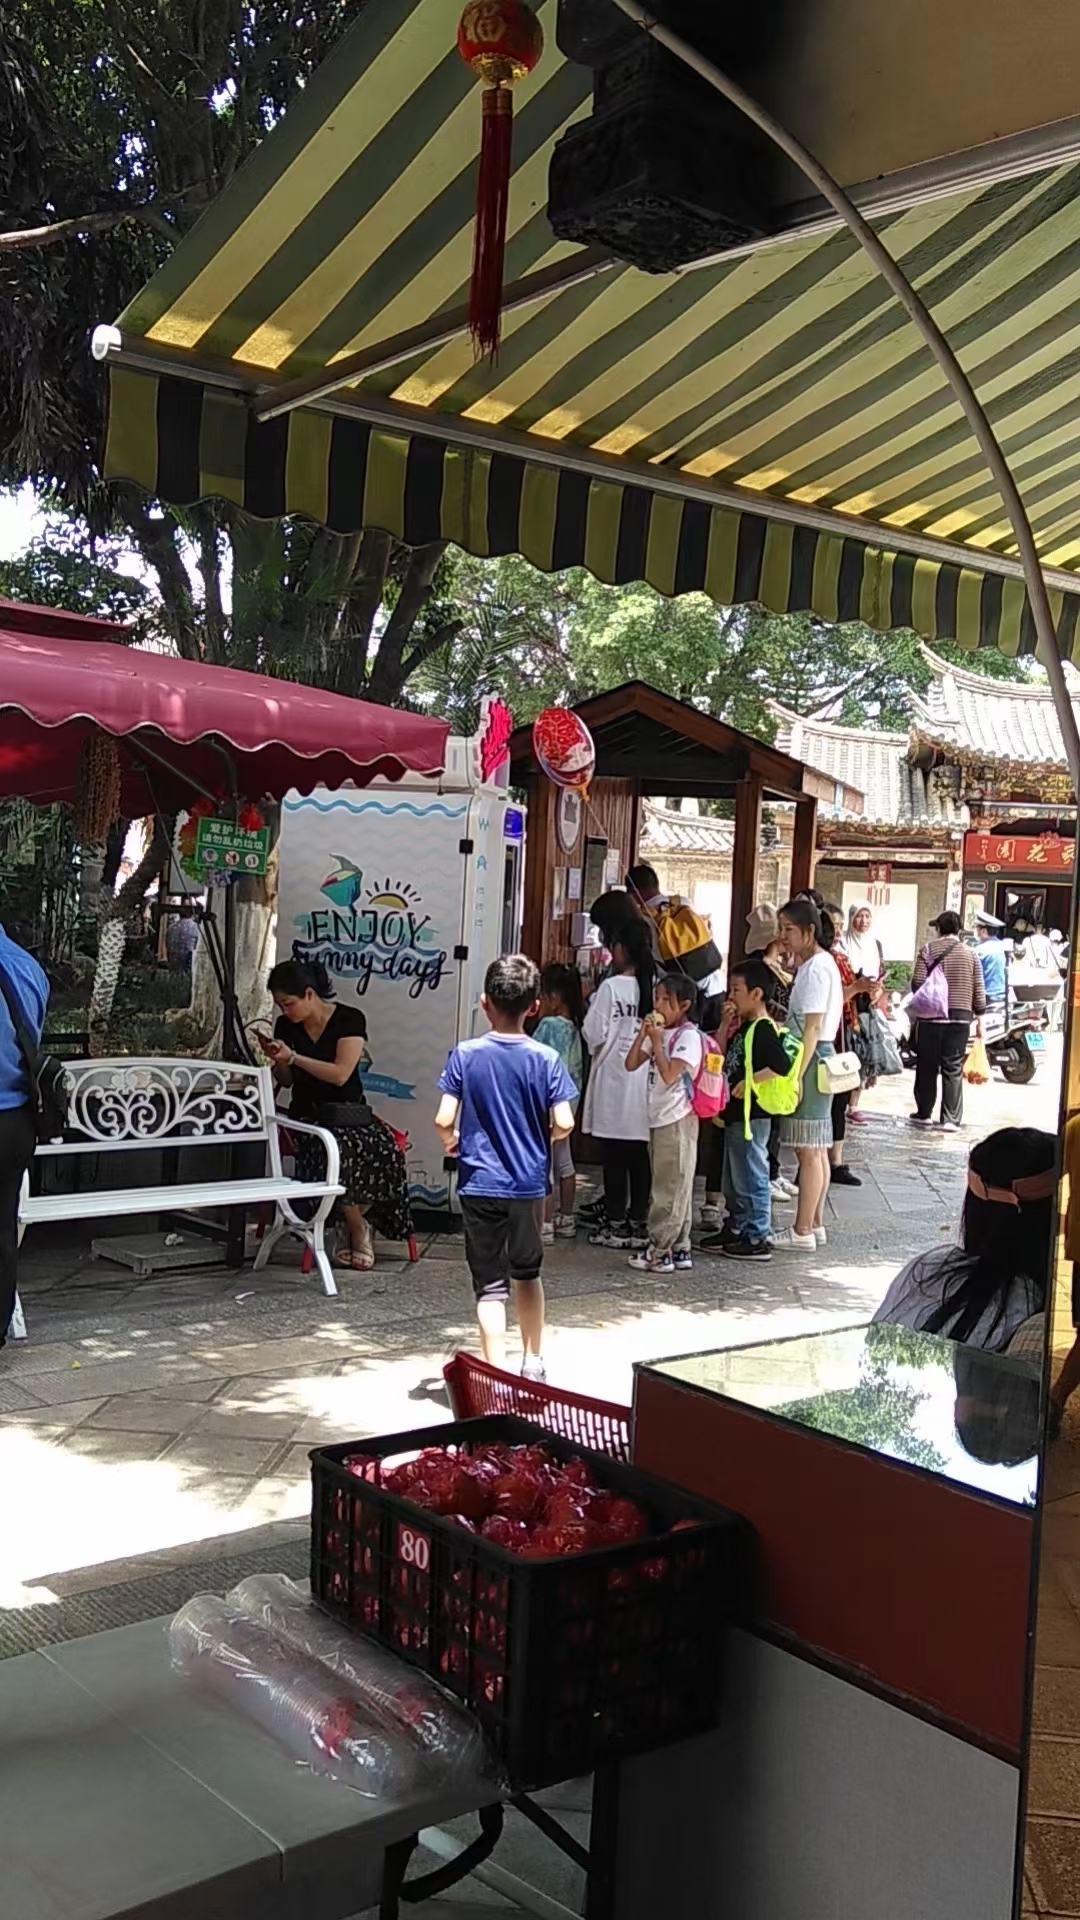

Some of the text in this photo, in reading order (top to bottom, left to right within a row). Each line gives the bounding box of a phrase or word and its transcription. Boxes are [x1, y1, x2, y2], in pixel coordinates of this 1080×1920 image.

[202, 833, 264, 850] 请勿乱扔垃圾
[308, 910, 431, 949] ENJOY
[383, 951, 453, 999] days
[401, 1530, 429, 1570] 80
